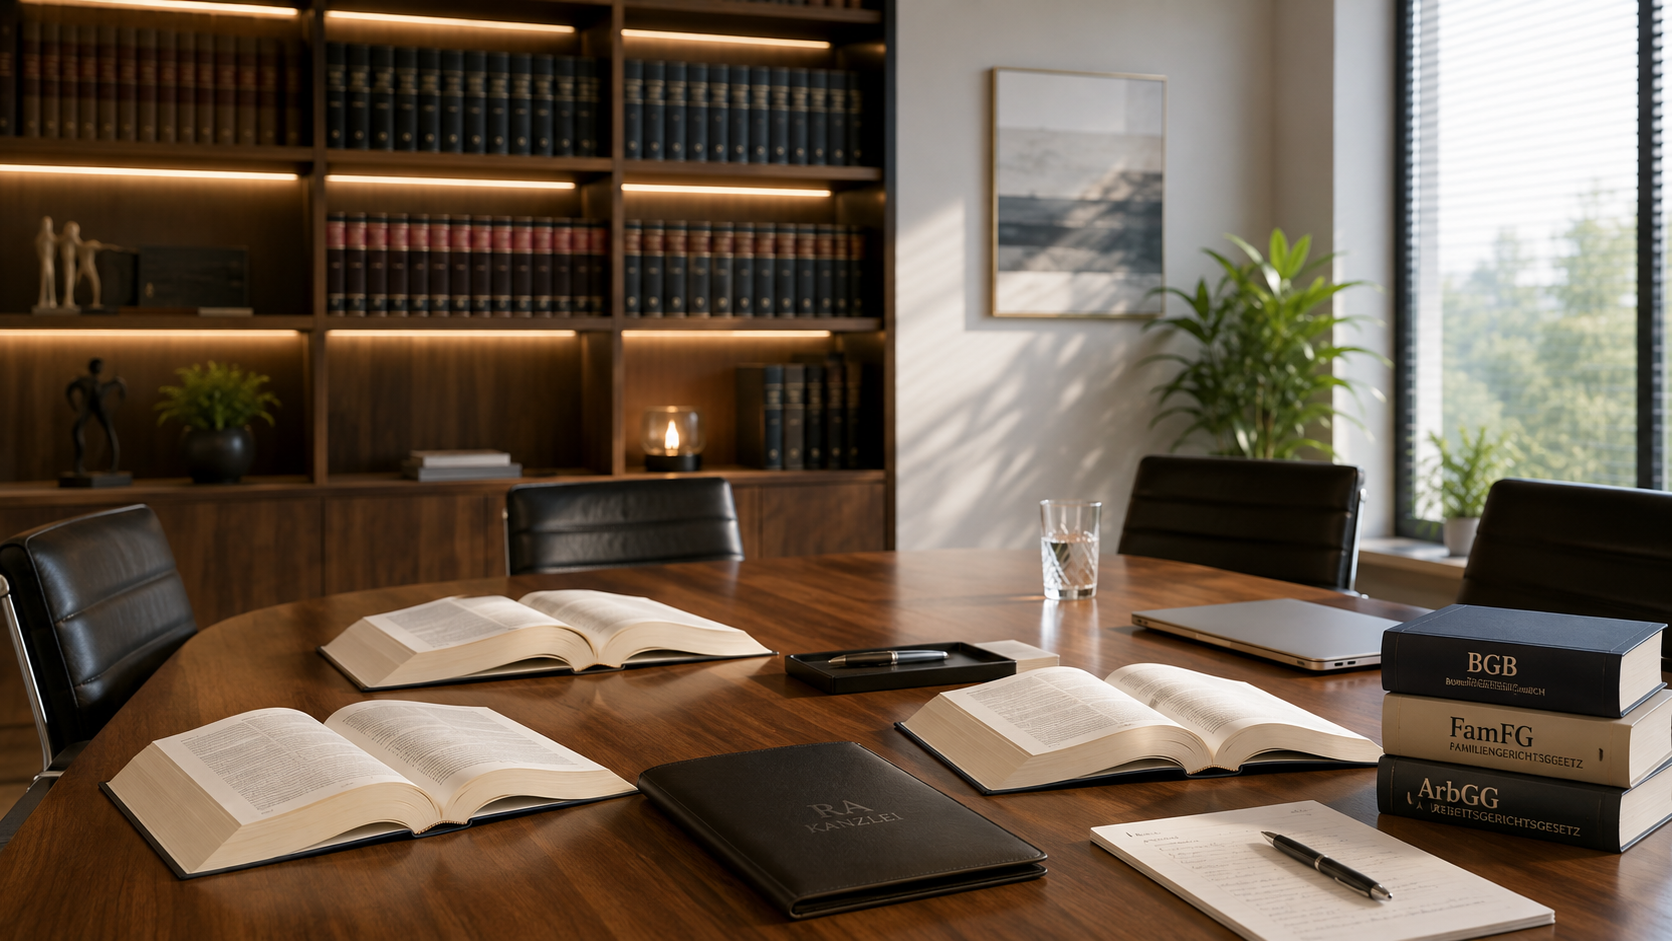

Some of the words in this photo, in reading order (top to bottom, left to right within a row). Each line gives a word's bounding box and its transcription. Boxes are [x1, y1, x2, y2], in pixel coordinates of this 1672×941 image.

[1467, 652, 1518, 677] BGB
[1449, 716, 1534, 747] FamFG
[1417, 777, 1500, 809] ArbGG
[806, 800, 873, 818] RA
[804, 812, 903, 833] KANZLEI
